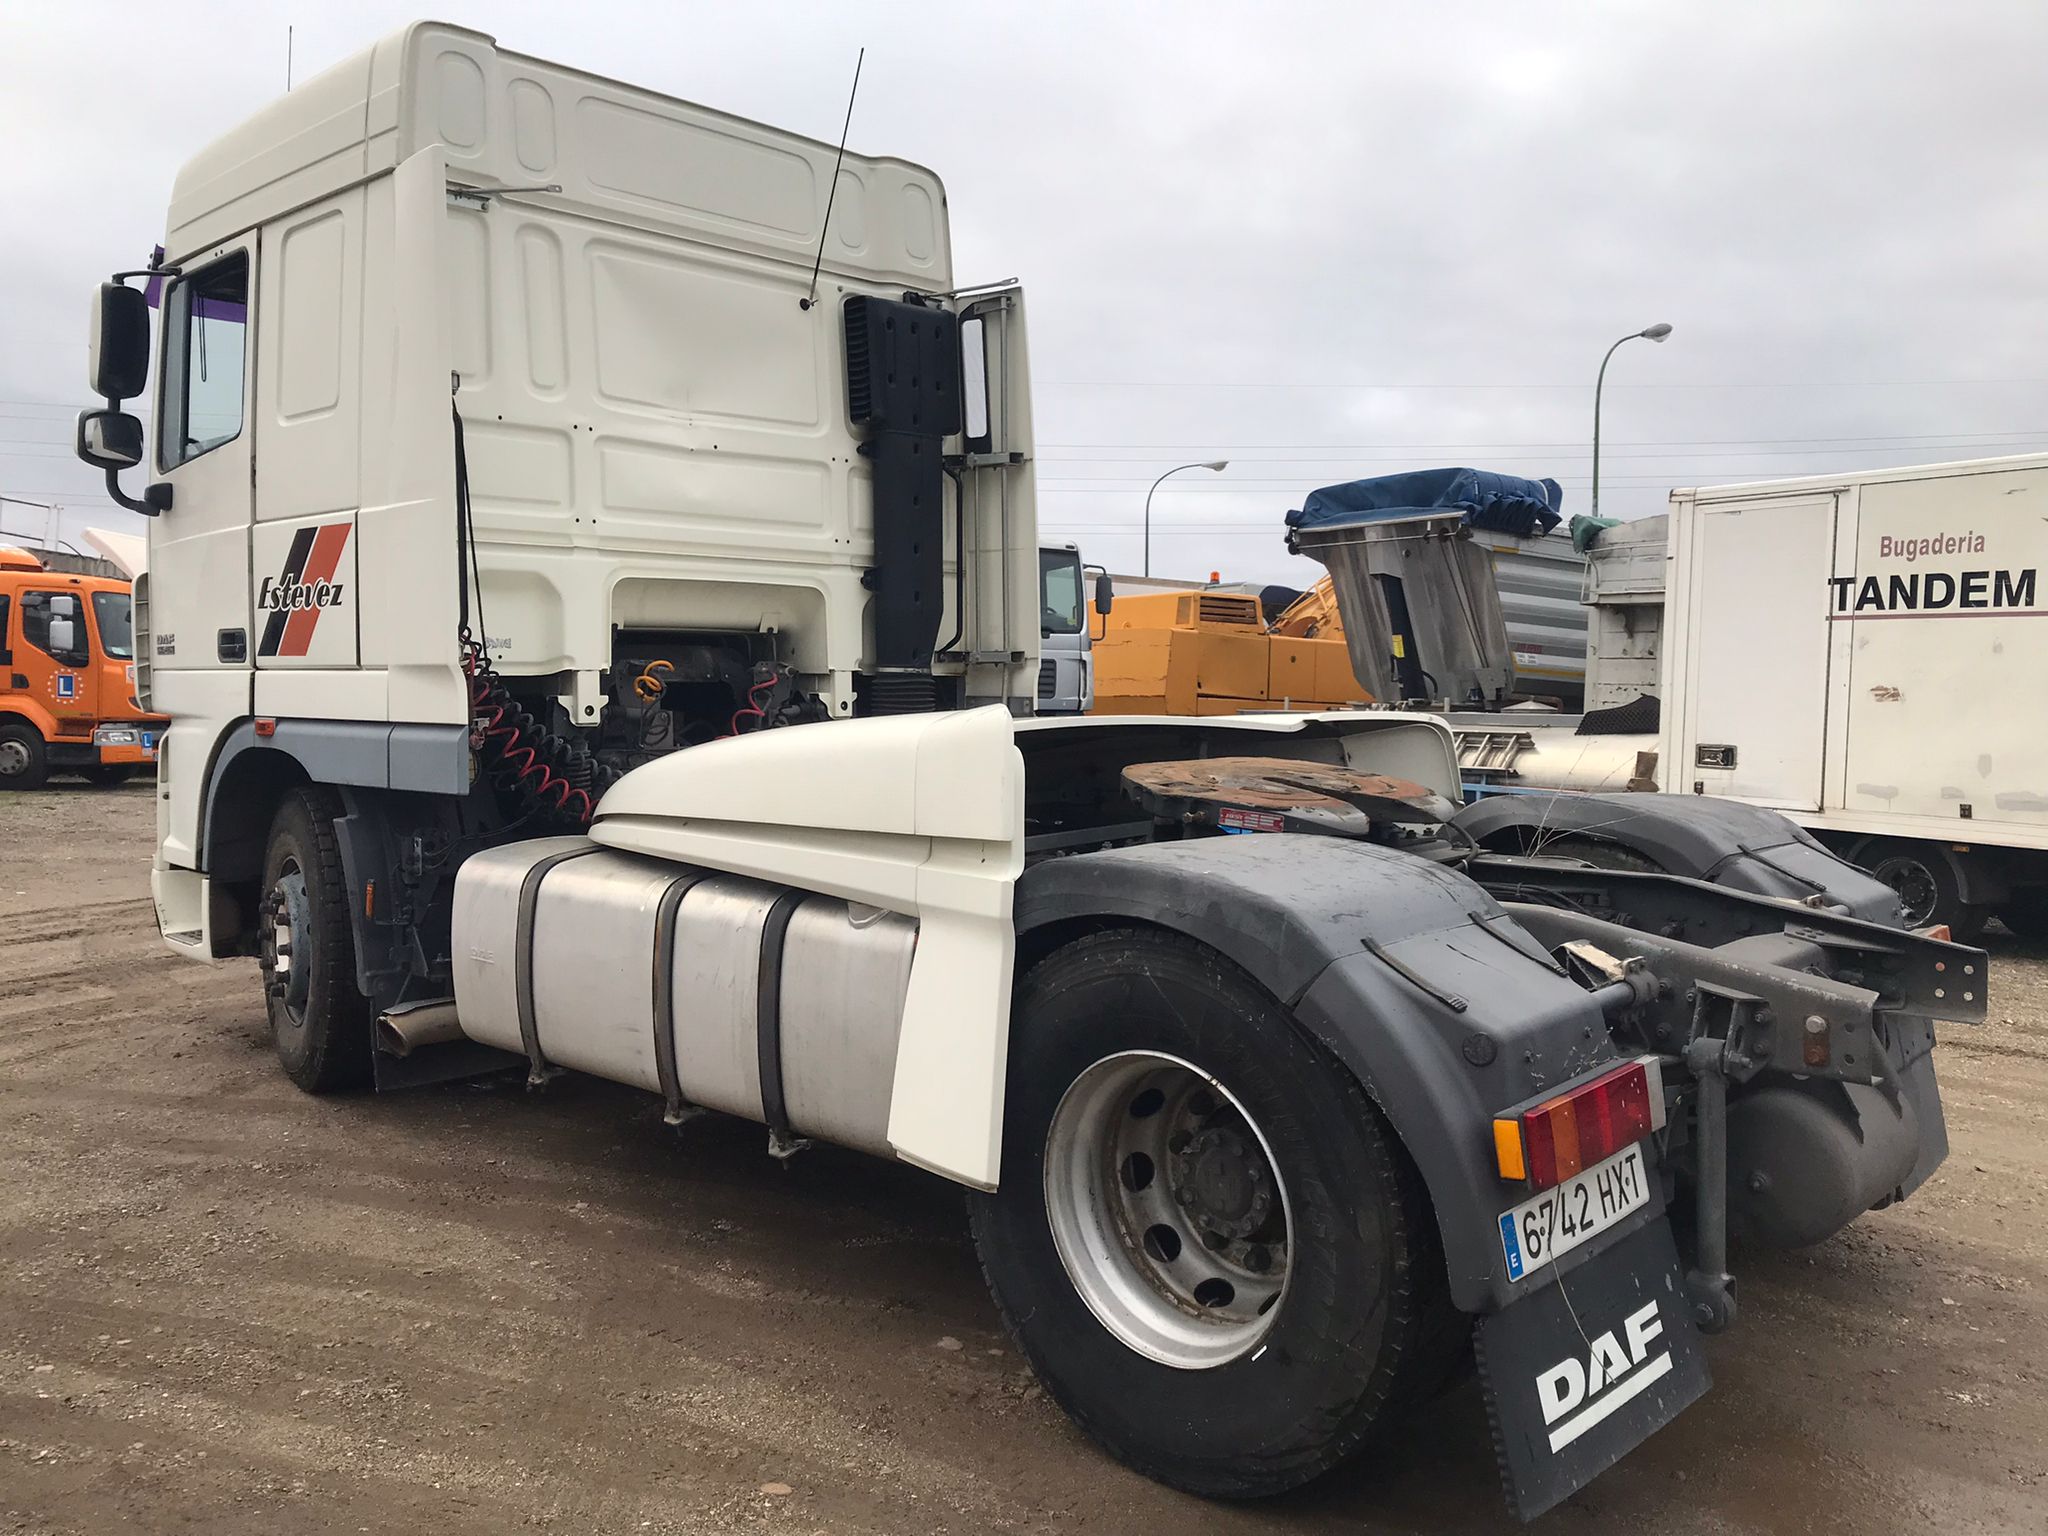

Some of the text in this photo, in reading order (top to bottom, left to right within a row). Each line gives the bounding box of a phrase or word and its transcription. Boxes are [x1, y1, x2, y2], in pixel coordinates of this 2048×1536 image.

[1880, 531, 1985, 562] Bugaderia
[258, 574, 344, 609] Estevez
[1828, 568, 2037, 612] TANDEM
[59, 677, 72, 696] L
[144, 735, 151, 747] L
[1510, 1153, 1639, 1269] E 6742 HXT
[1536, 1299, 1664, 1427] DAF
